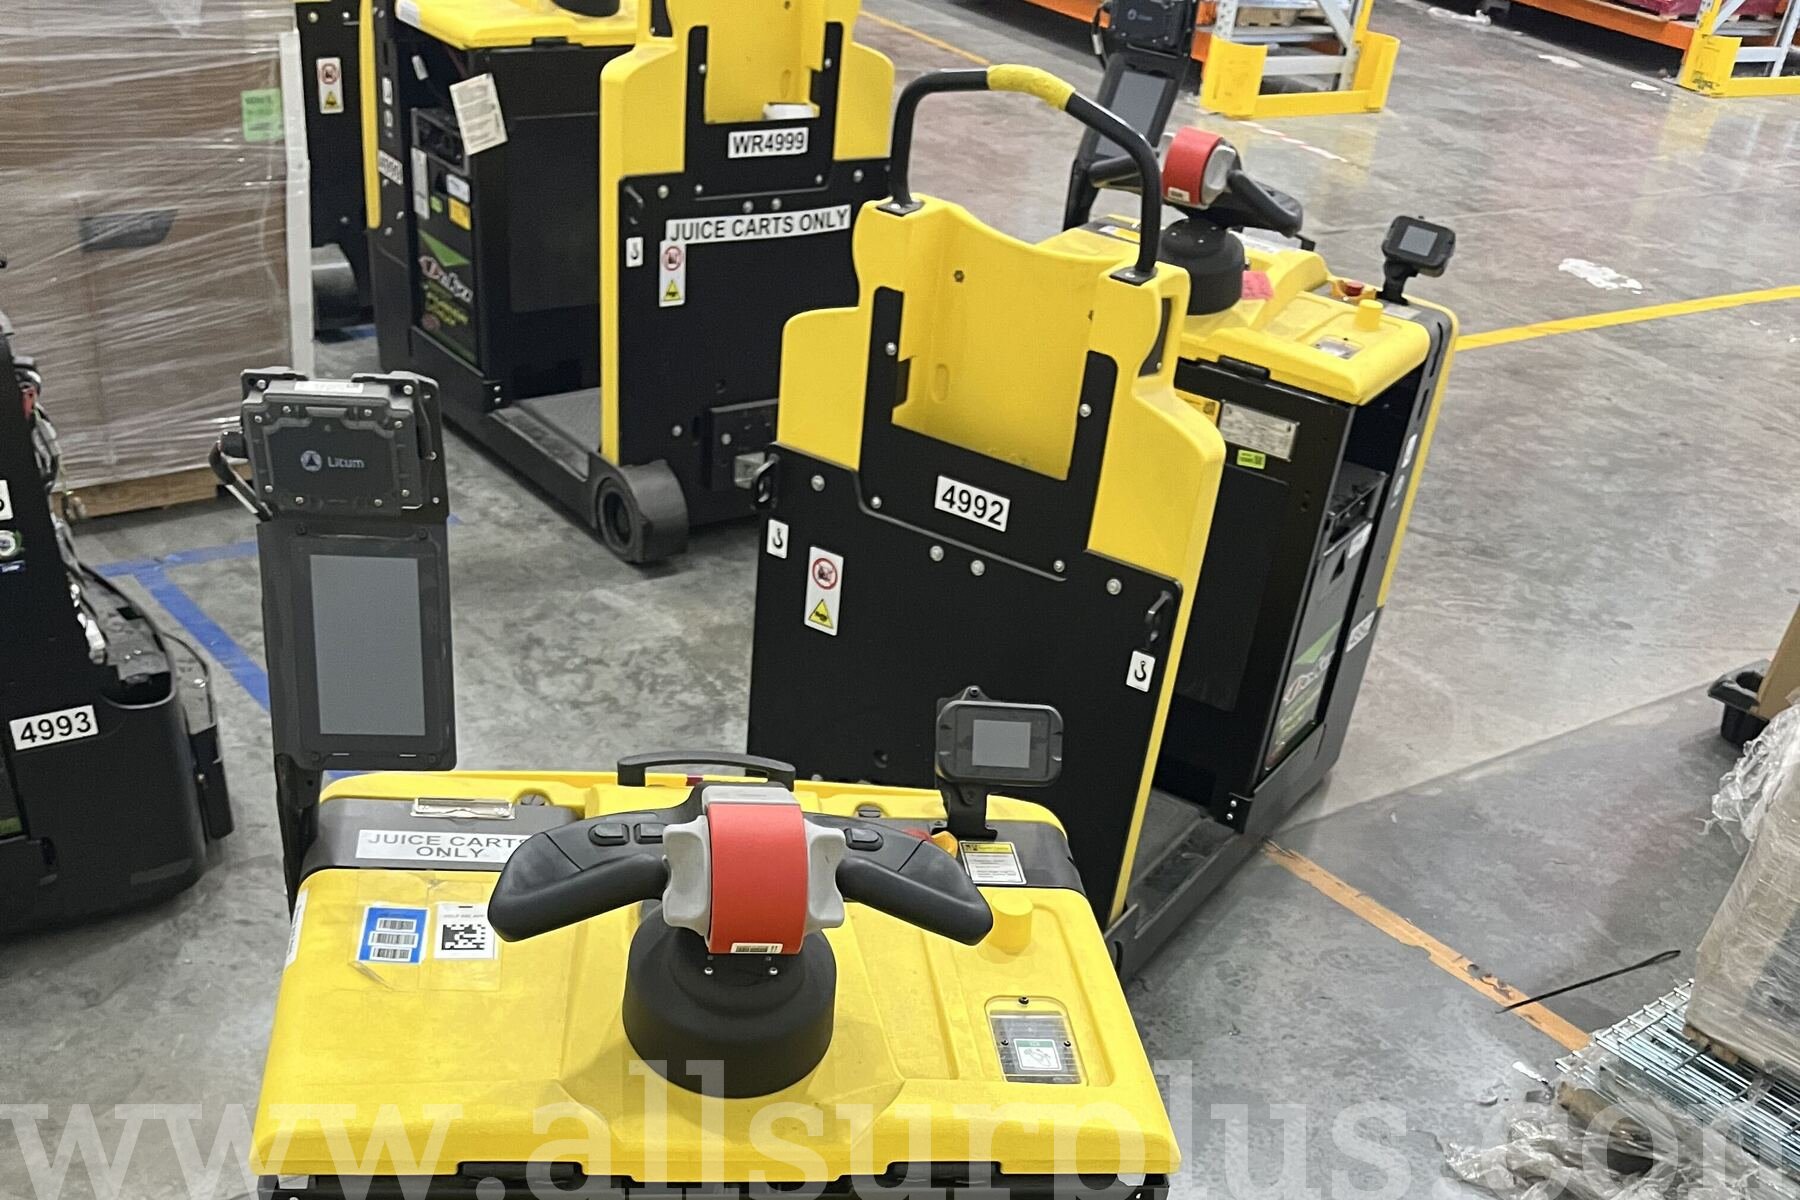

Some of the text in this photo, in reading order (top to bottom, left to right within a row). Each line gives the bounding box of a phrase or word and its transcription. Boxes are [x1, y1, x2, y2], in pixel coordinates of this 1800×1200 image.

[732, 131, 805, 154] WR4999
[670, 207, 849, 241] JUICE CARTS ONLY
[941, 485, 1004, 526] 4992
[19, 710, 92, 744] 4993
[368, 833, 441, 846] JUICE
[416, 846, 484, 858] ONLY
